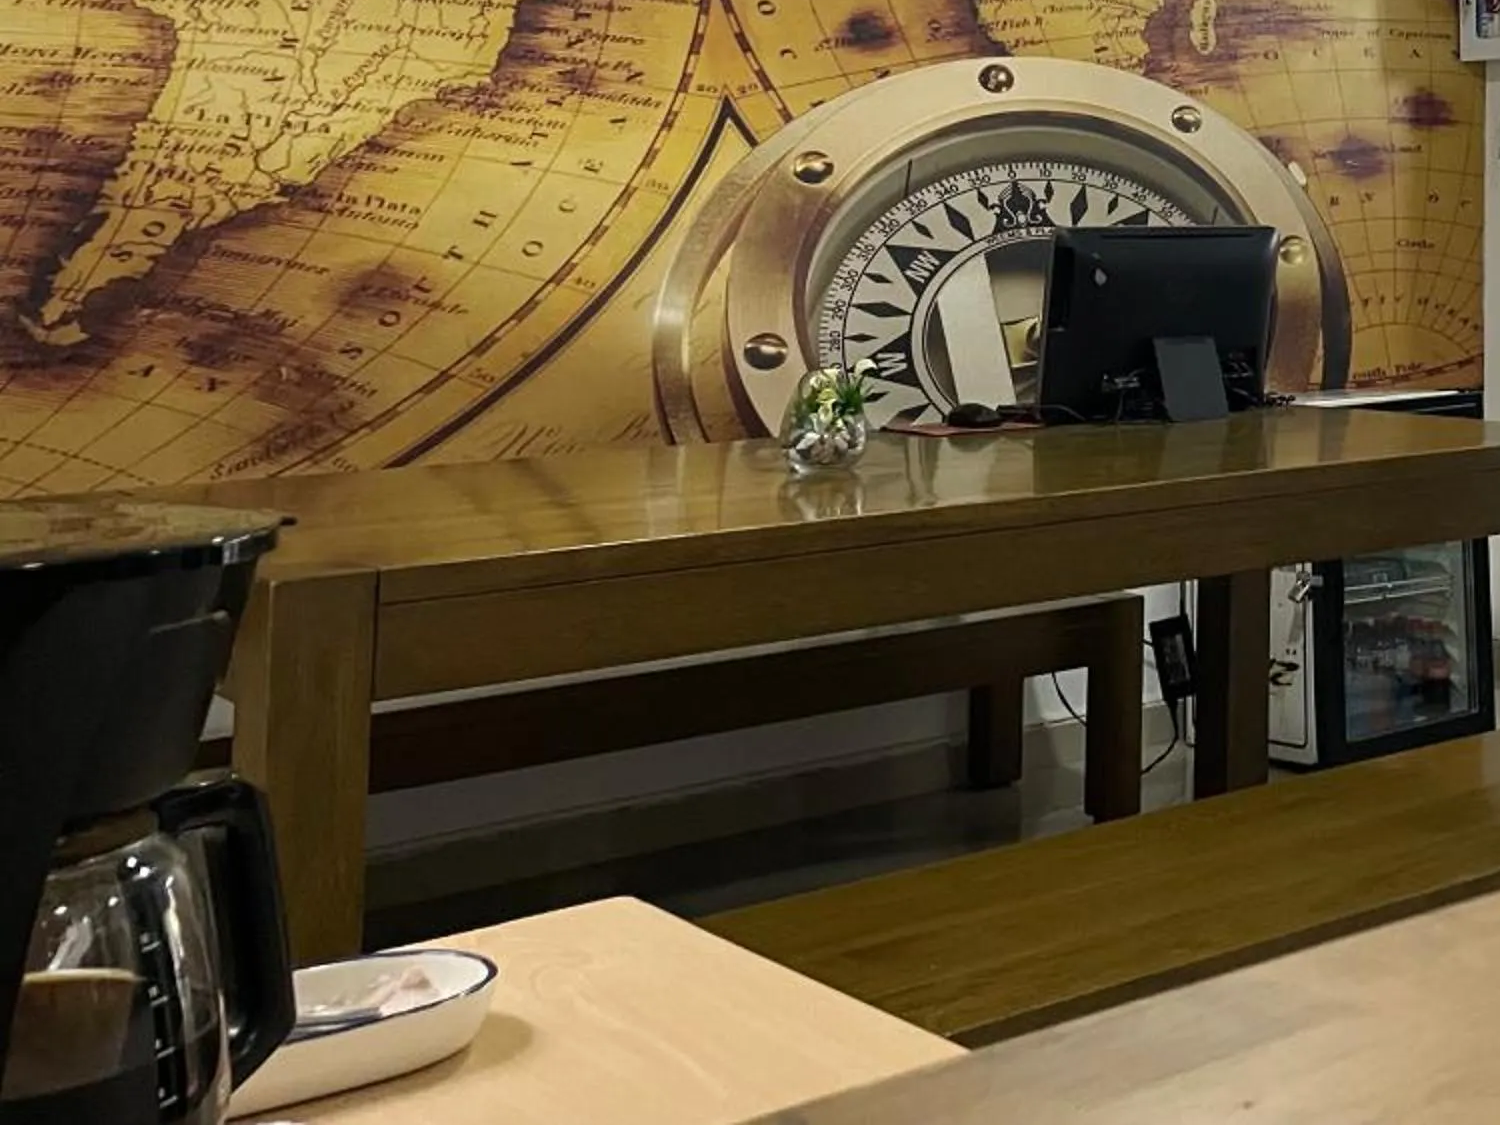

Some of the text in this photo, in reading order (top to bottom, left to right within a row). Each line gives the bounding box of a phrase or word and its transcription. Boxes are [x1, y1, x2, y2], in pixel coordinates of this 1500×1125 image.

[904, 249, 941, 284] NW
[831, 298, 846, 321] 290
[840, 267, 859, 293] 300
[876, 352, 908, 376] W
